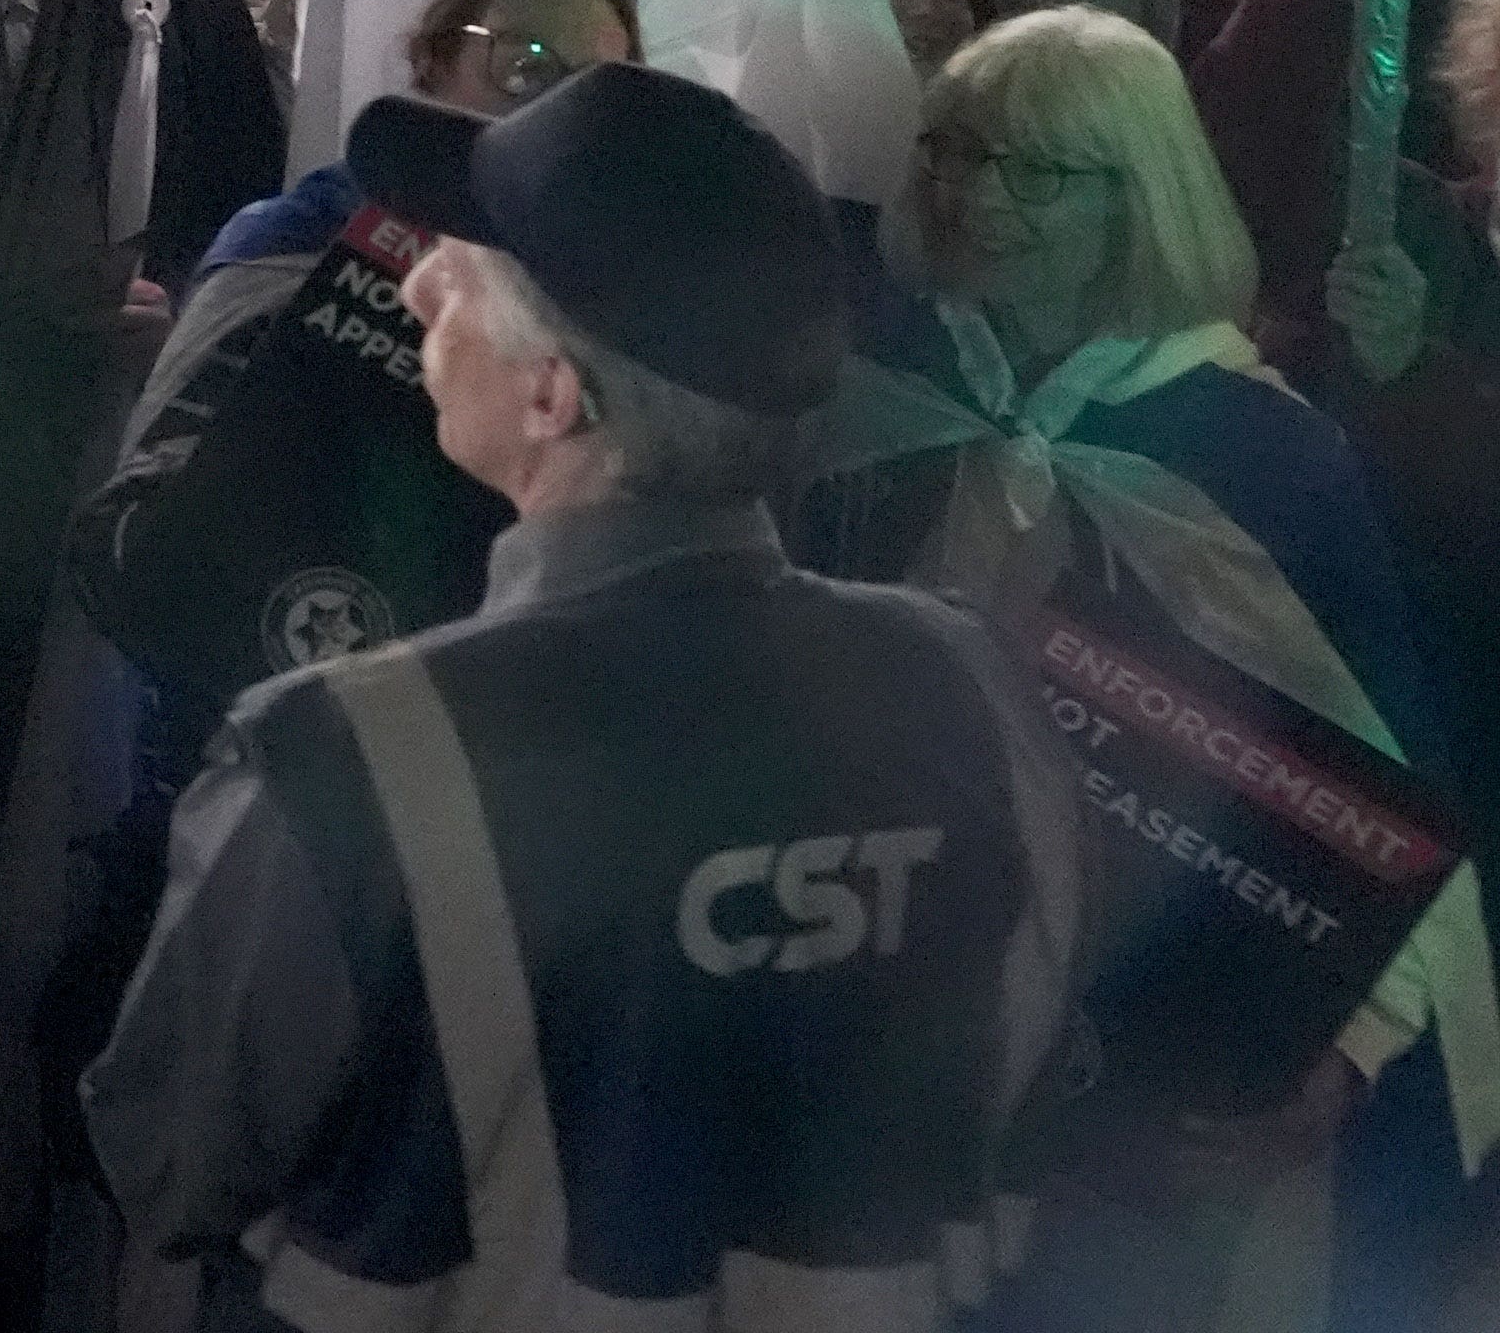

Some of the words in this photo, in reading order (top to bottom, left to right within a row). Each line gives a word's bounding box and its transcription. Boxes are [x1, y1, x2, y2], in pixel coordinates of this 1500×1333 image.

[1041, 686, 1120, 748] OT
[1045, 630, 1411, 863] ENFORCEMENT
[678, 827, 946, 977] CST
[1083, 768, 1341, 942] EASEMENT
